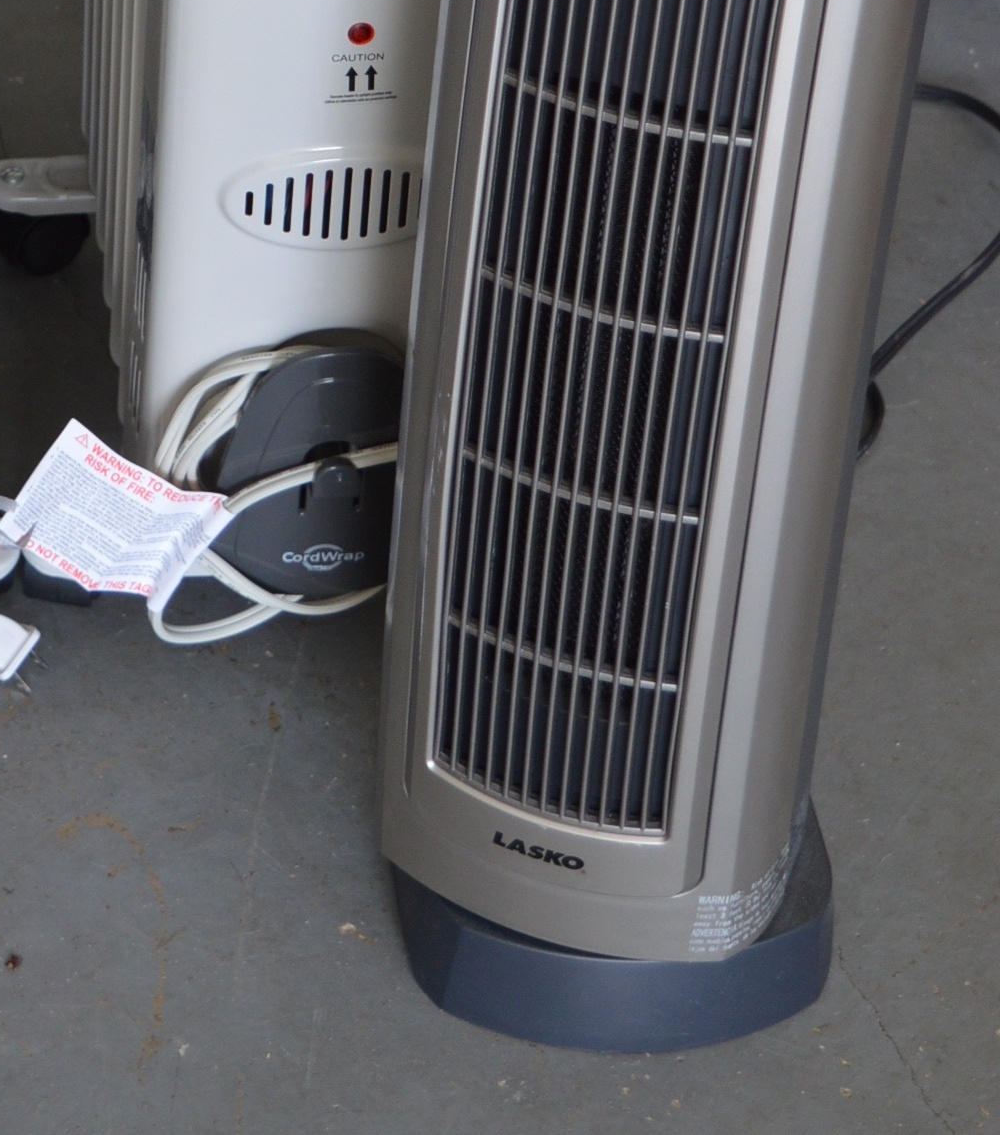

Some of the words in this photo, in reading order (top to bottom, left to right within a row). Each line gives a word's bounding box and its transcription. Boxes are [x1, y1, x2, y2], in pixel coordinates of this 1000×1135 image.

[331, 52, 386, 63] CAUTION
[84, 453, 111, 478] RISK
[111, 472, 128, 486] OF
[147, 476, 163, 492] TO
[35, 544, 60, 563] NOT
[104, 580, 127, 590] THIS
[281, 550, 365, 564] CordWrap
[492, 830, 585, 871] LASKO
